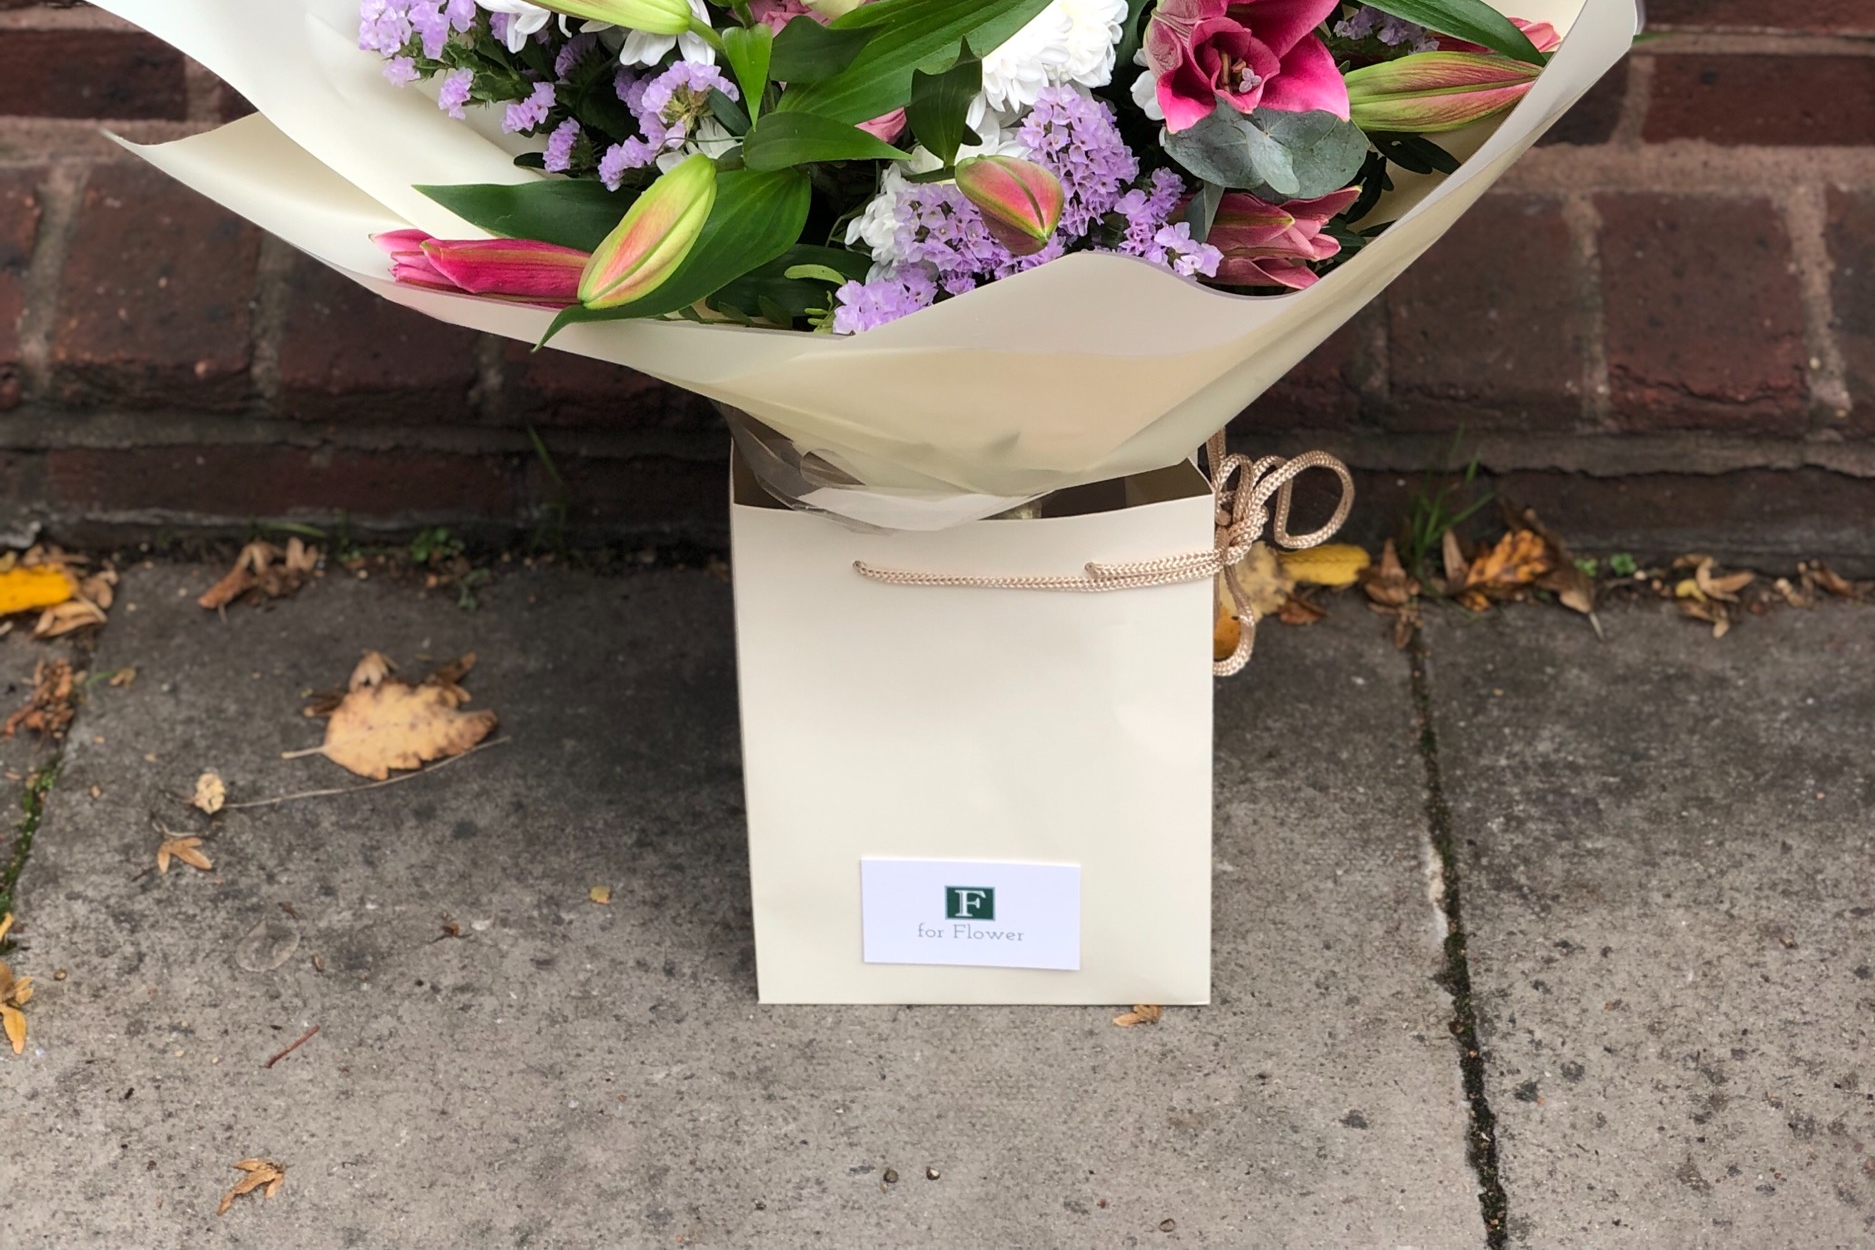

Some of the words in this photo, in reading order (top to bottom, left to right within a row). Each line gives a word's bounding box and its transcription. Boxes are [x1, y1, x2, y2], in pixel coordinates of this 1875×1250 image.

[954, 889, 987, 917] F
[917, 922, 944, 938] for
[953, 923, 1025, 941] Flower
